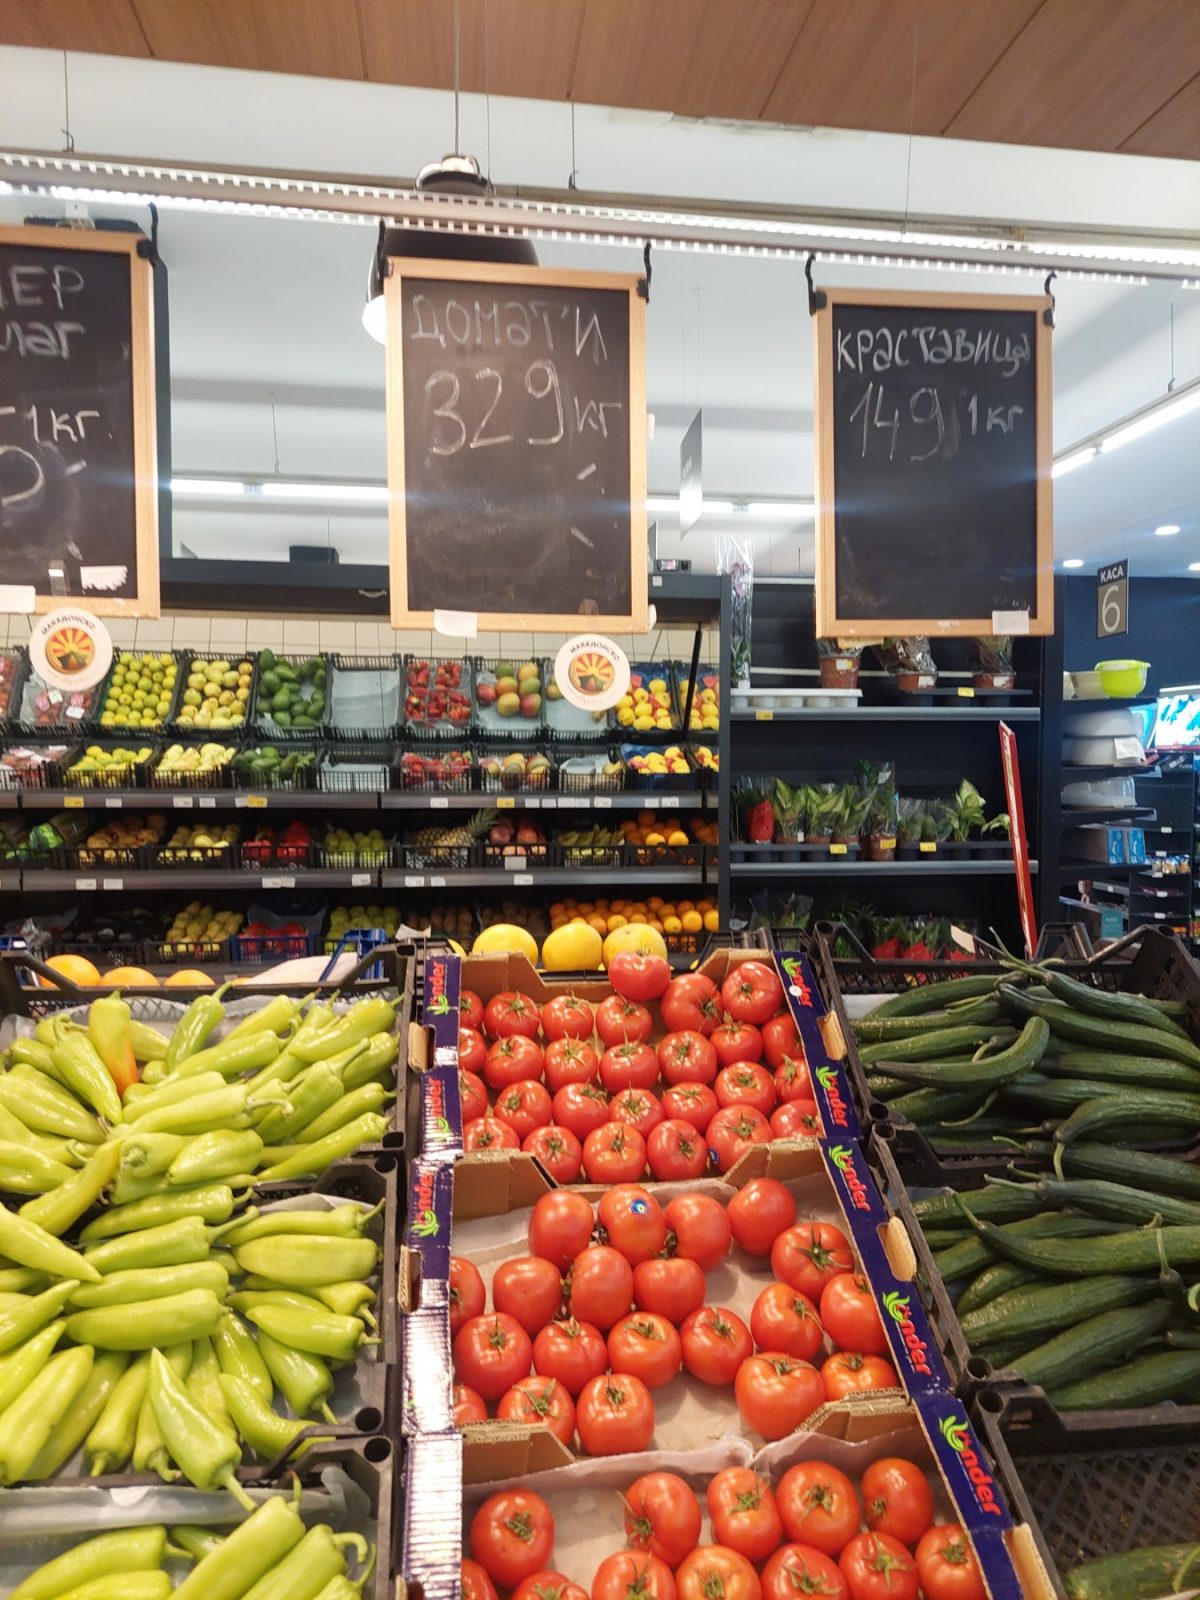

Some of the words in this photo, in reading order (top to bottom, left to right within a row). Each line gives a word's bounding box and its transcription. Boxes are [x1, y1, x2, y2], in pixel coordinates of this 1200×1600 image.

[0, 264, 84, 310] ЕР
[1100, 565, 1124, 584] КАСА
[1102, 585, 1121, 633] 6
